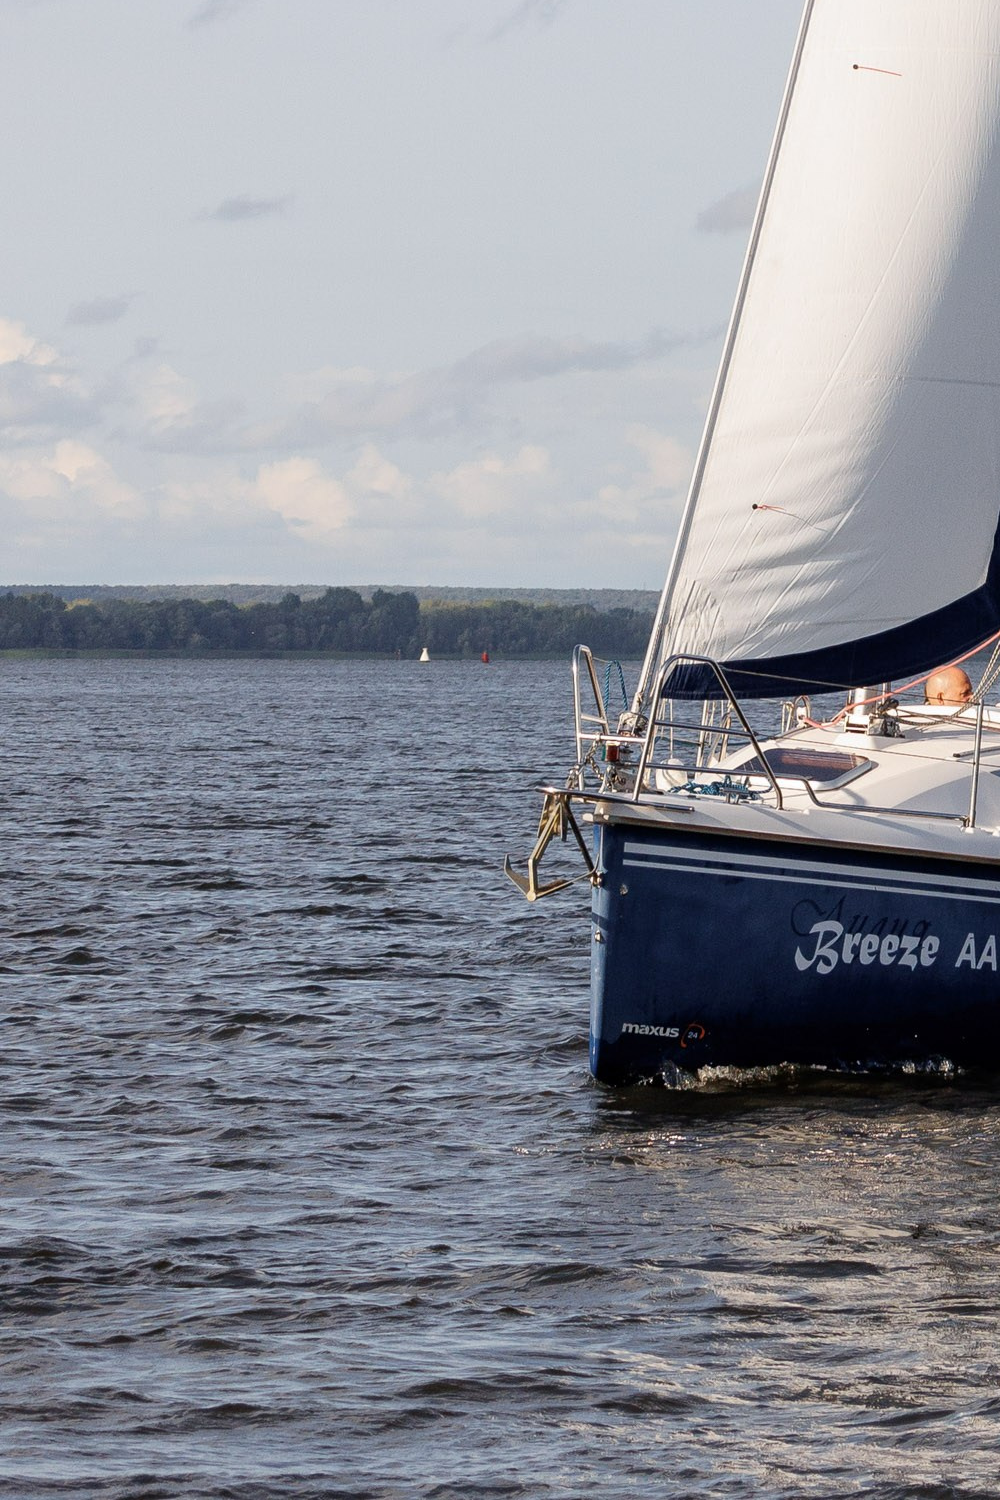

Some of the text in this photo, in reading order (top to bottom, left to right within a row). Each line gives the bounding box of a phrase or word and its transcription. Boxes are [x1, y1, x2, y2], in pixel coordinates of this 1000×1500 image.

[794, 920, 940, 975] Breeze
[955, 932, 997, 972] AA
[621, 1022, 699, 1039] maxus 24
